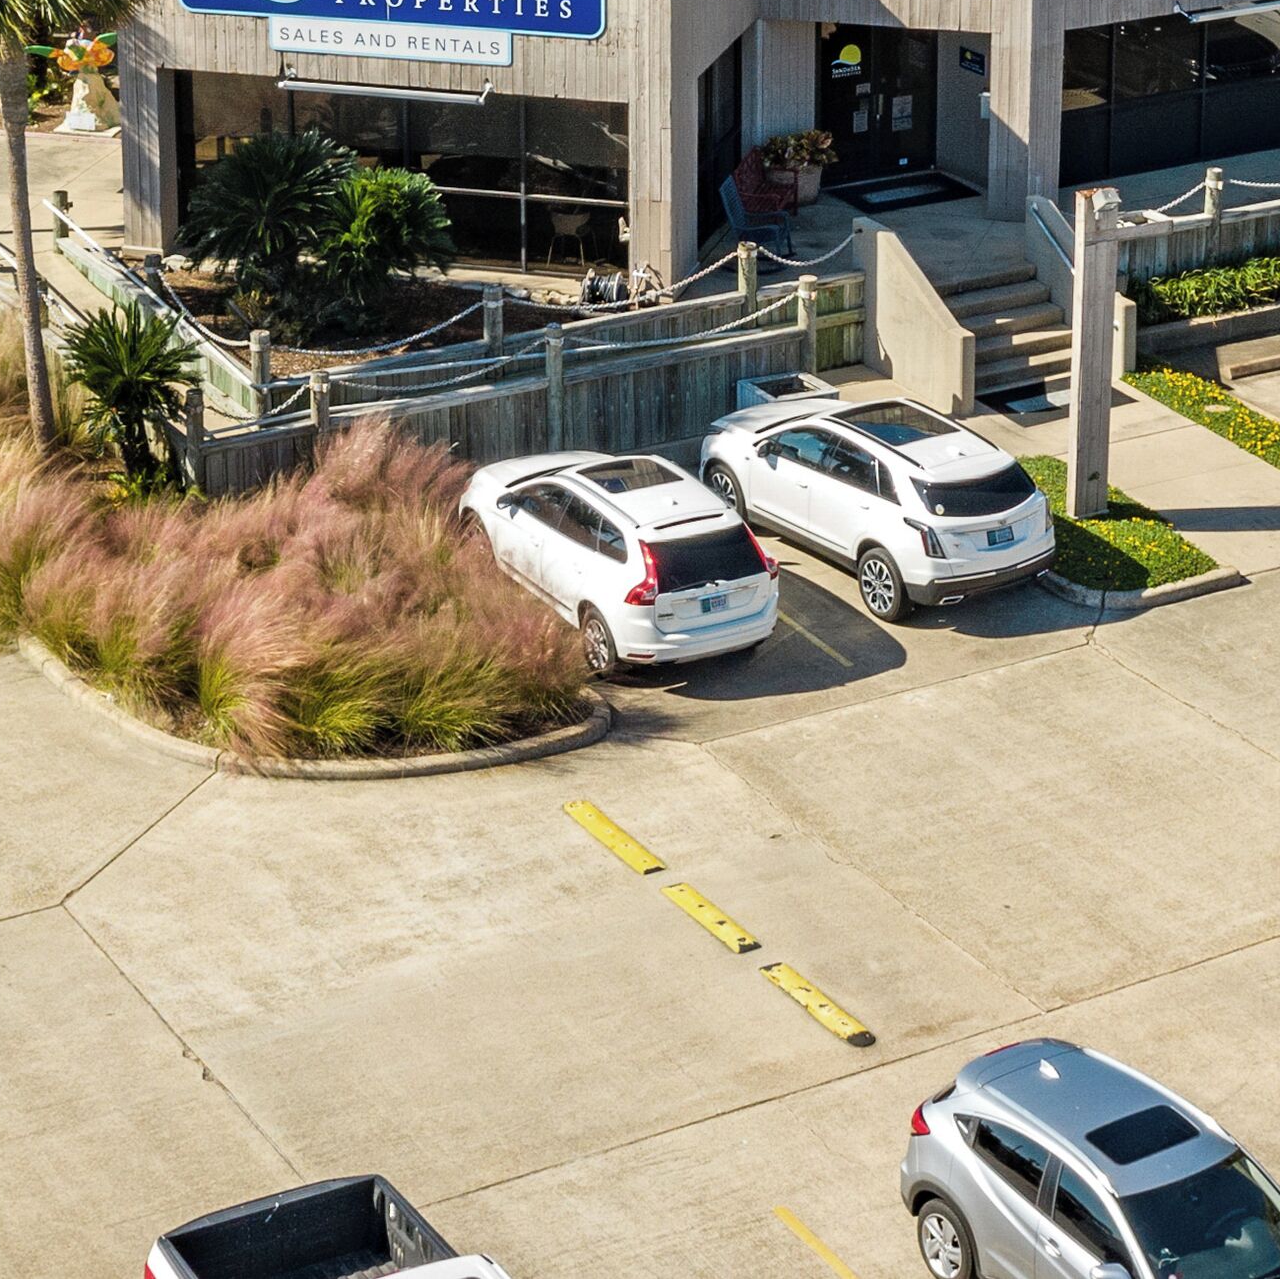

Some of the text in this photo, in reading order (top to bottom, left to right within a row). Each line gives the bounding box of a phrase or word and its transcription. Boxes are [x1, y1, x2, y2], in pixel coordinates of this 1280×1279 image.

[279, 27, 502, 56] SALES AND RENTALS
